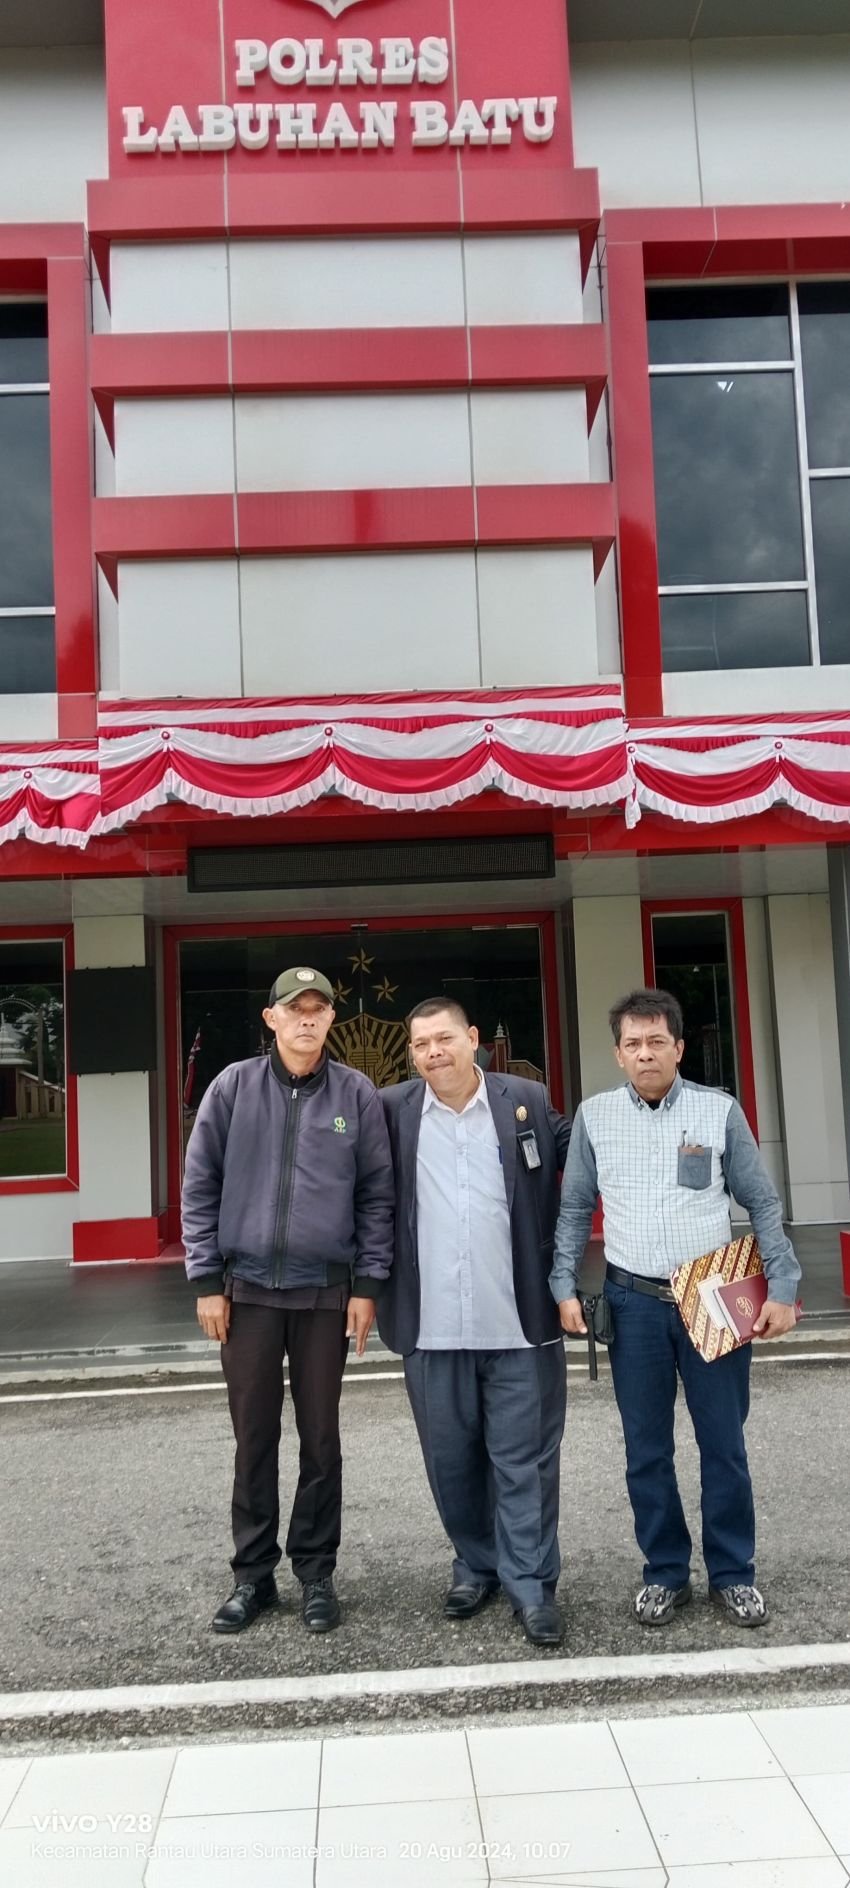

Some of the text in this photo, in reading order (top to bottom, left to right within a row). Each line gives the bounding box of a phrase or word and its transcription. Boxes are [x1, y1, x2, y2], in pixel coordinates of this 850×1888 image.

[235, 36, 449, 86] POLRES
[122, 96, 557, 153] LABUHAN BATU
